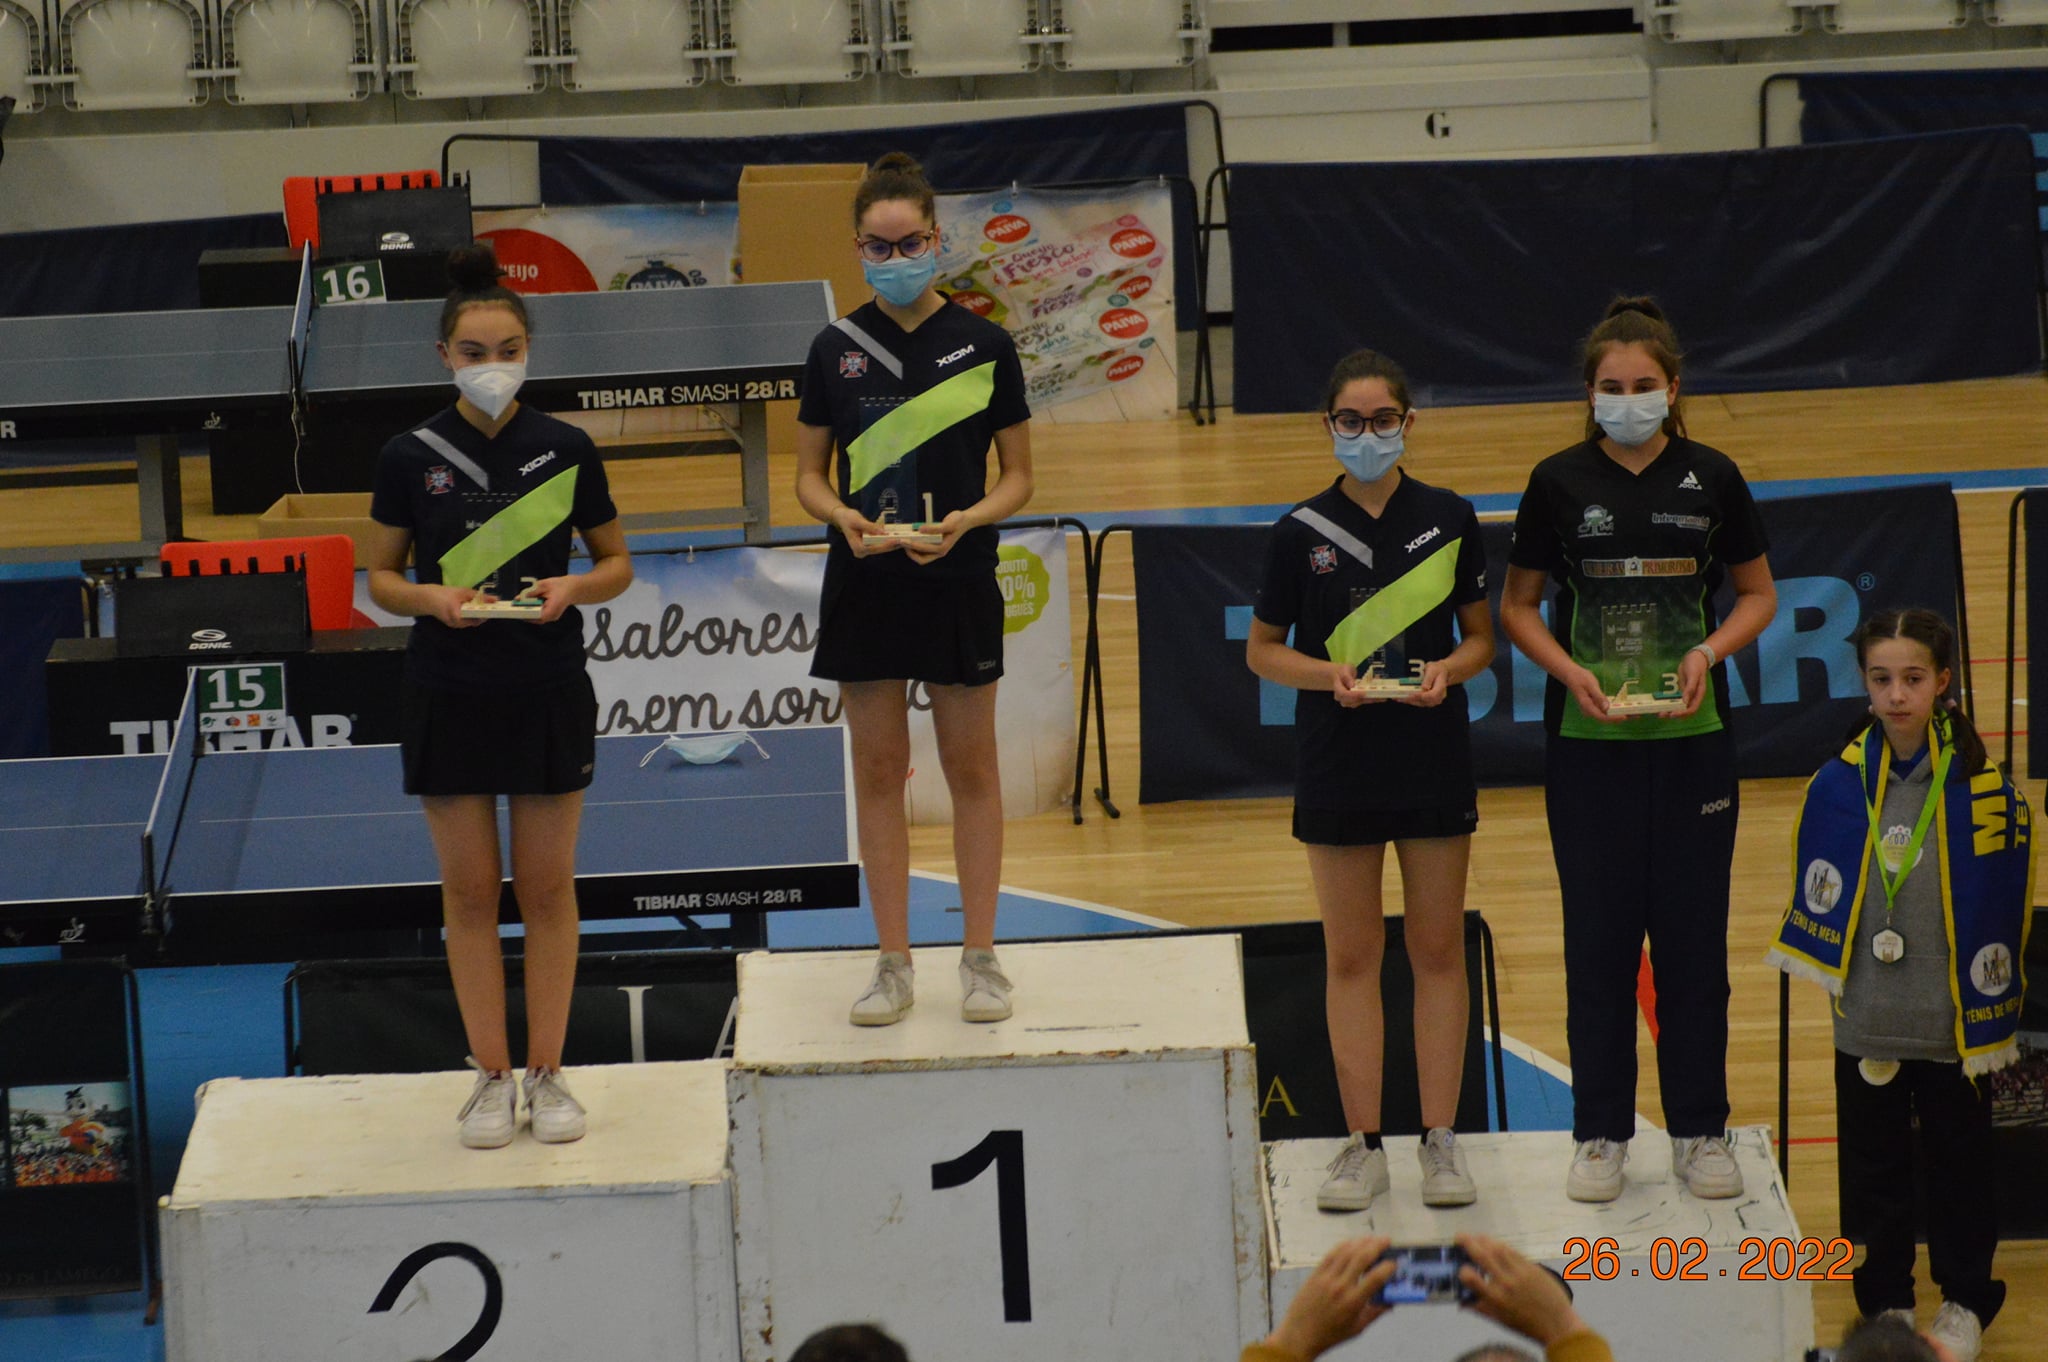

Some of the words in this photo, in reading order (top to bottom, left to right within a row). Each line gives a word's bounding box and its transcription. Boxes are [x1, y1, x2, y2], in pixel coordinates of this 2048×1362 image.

[1425, 112, 1451, 138] G
[987, 221, 1027, 240] PAIVA
[1114, 235, 1152, 251] PAIVA
[323, 266, 370, 302] 16
[502, 264, 538, 281] EIJO
[1103, 314, 1145, 332] PAIVA
[936, 344, 975, 368] XIOM
[578, 388, 664, 409] TIBHAR
[671, 384, 739, 403] SMASH
[745, 379, 796, 399] 28/R
[518, 451, 557, 476] XIOM
[1404, 526, 1440, 553] XIOM
[189, 642, 232, 650] DONIC
[1408, 659, 1425, 683] 3
[206, 668, 266, 710] 15
[1662, 672, 1679, 695] 3
[633, 894, 701, 911] TIBHAR
[705, 891, 759, 907] SMASH
[763, 888, 802, 905] 28/R
[1808, 920, 1818, 937] DE
[1818, 925, 1841, 946] MESA
[1994, 1003, 2005, 1018] DE
[931, 1130, 1031, 1323] 1
[367, 1242, 503, 1362] 2
